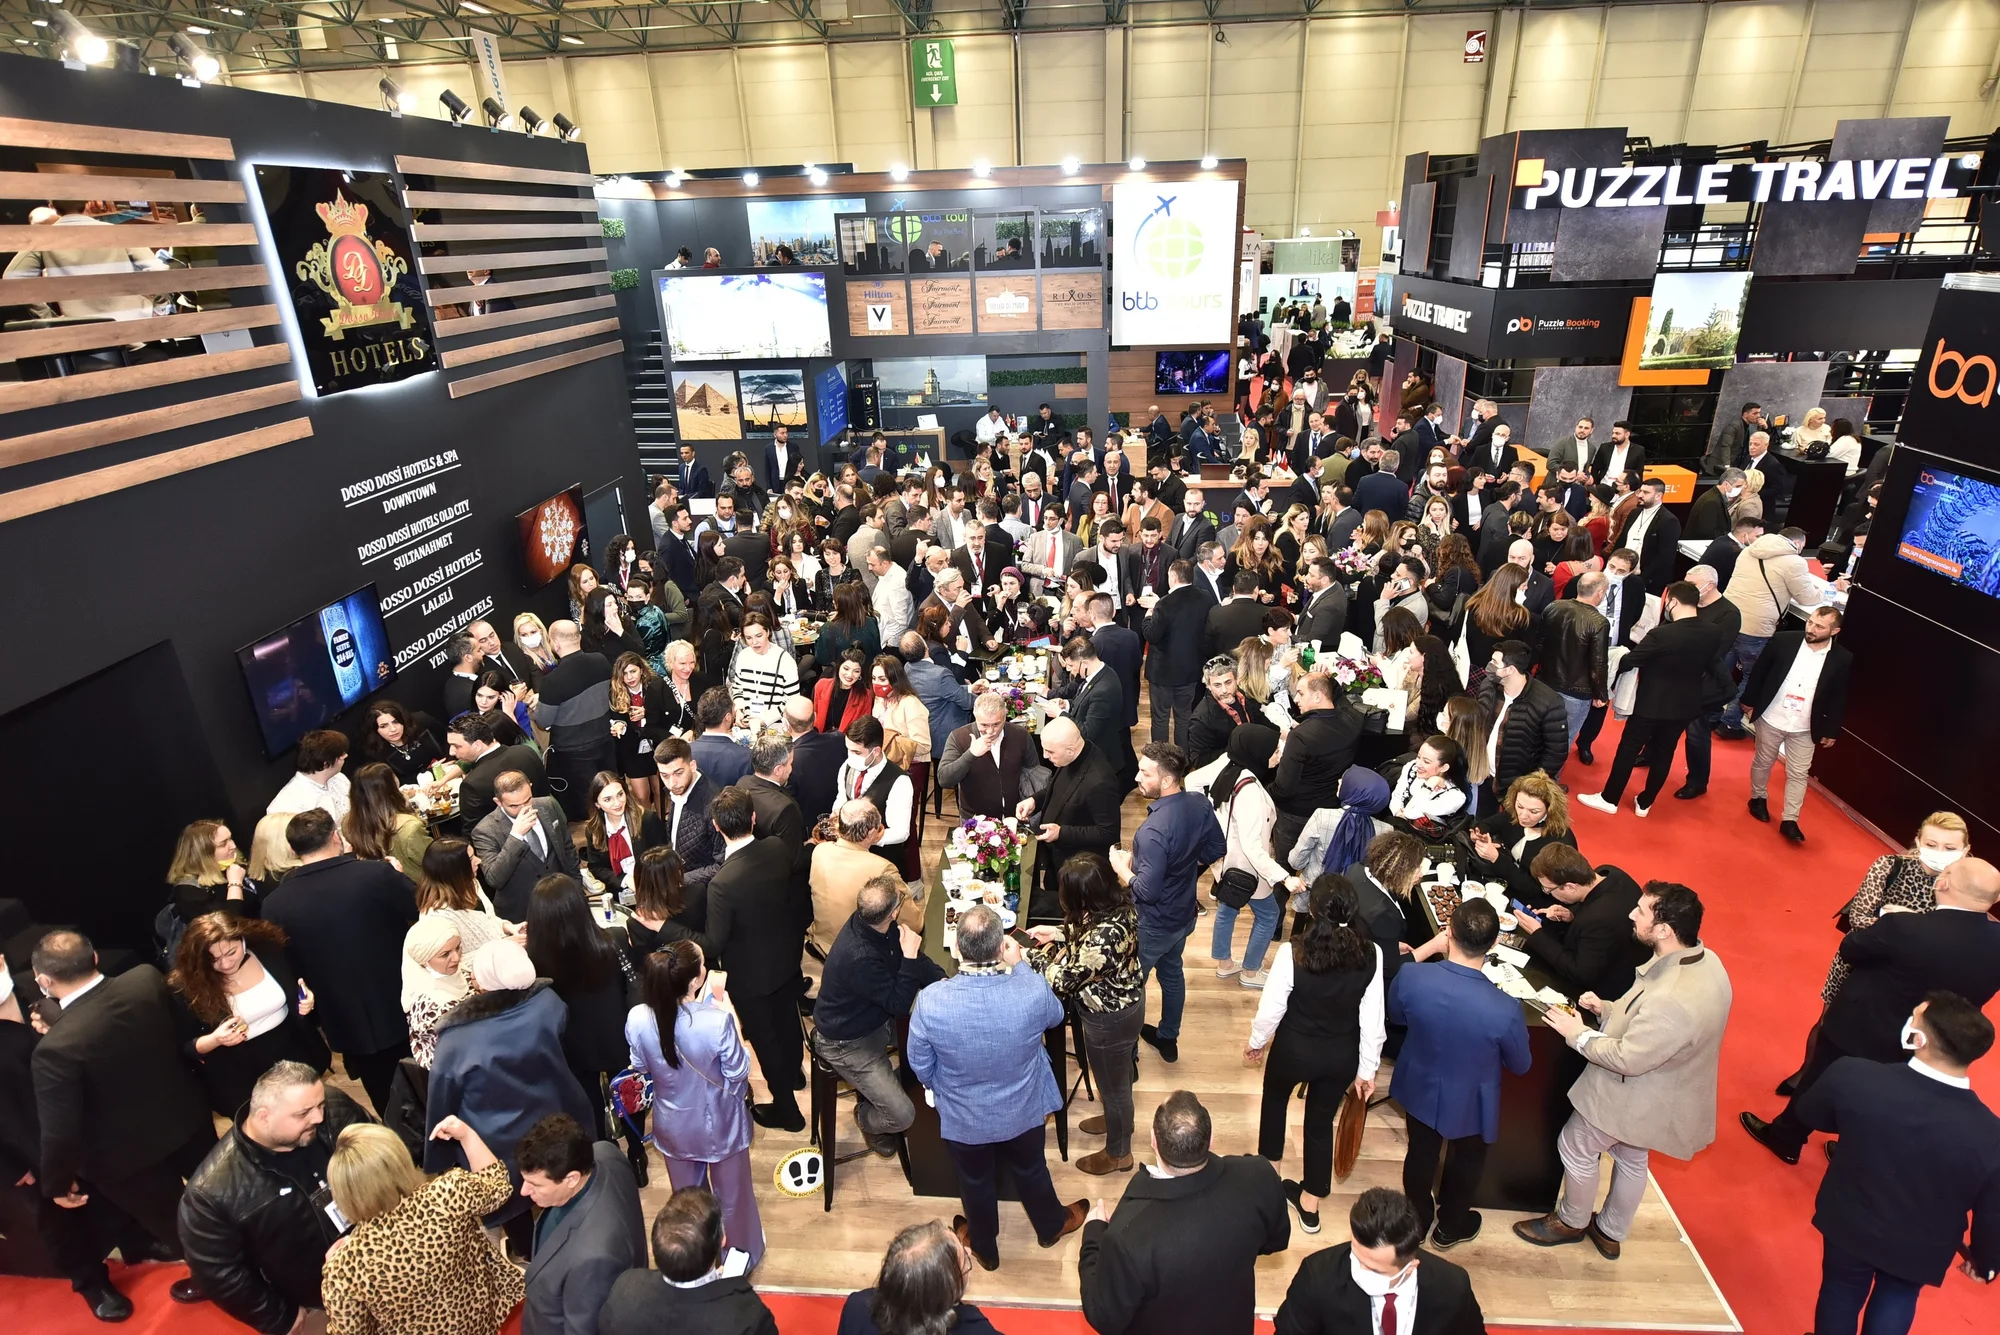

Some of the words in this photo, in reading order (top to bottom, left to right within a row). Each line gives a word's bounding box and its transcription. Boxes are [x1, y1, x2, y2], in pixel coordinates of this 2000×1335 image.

[483, 37, 500, 88] Group
[1524, 164, 1732, 210] PUZZLE
[1751, 157, 1960, 202] TRAVEL
[864, 290, 893, 299] Hilton
[921, 280, 960, 294] Fairmont
[1122, 291, 1158, 311] btb
[872, 307, 886, 322] V
[922, 297, 960, 310] Fairmont
[922, 312, 961, 327] Fairmont
[1402, 298, 1433, 323] PUZZLE
[1433, 304, 1468, 334] TRAVEL
[1538, 319, 1564, 328] Puzzle
[1566, 318, 1600, 329] Booking
[329, 337, 424, 377] HOTELS
[340, 482, 376, 502] DOSSO
[374, 466, 404, 490] DOSSİ
[403, 457, 436, 479] HOTELS
[436, 454, 444, 466] &
[443, 449, 460, 464] SPA
[382, 482, 438, 514] DOWNTOWN
[357, 537, 388, 560] DOSSO
[386, 523, 411, 547] DOSSİ
[410, 512, 440, 536] HOTELS
[438, 507, 456, 524] OLD
[454, 499, 472, 516] CITY
[393, 532, 454, 571] SULTANAHMET
[412, 568, 444, 594] DOSSİ
[444, 549, 482, 577] HOTELS
[422, 586, 454, 616] LALELİ
[426, 616, 458, 646] DOSSİ
[458, 595, 494, 626] HOTELS
[798, 1189, 818, 1198] SOCIAL
